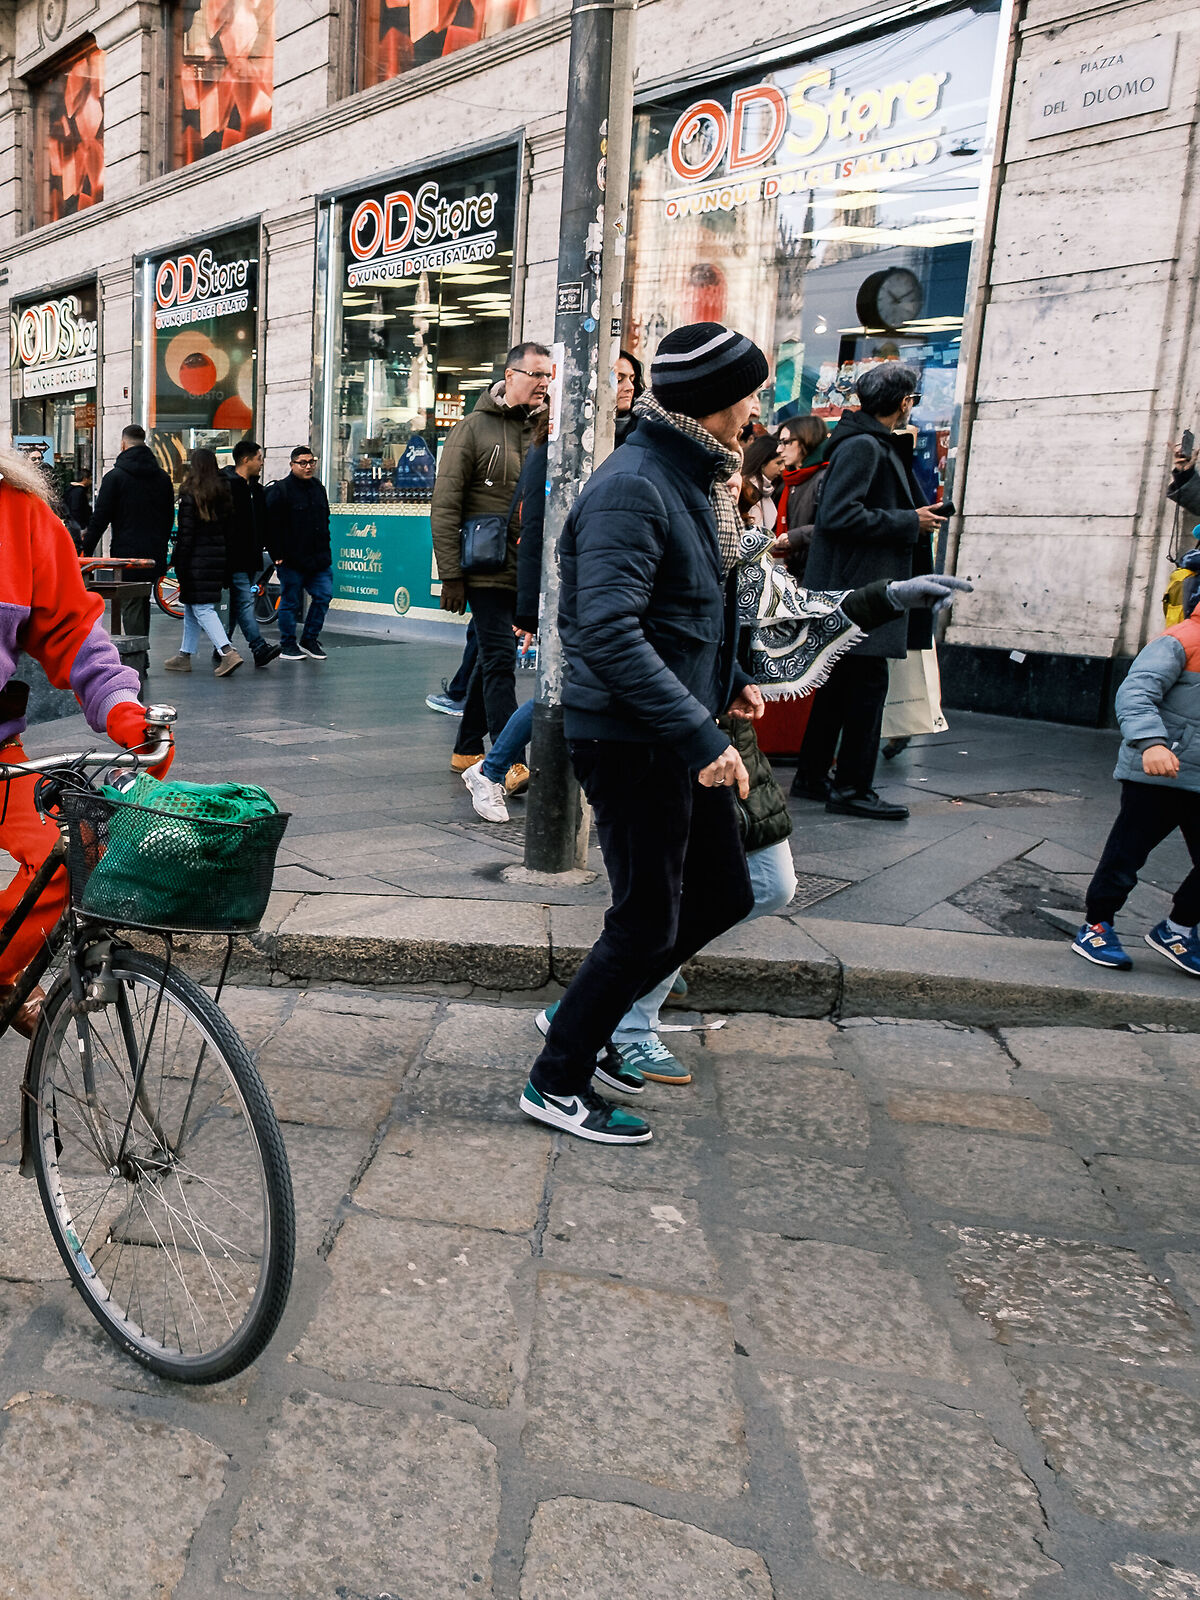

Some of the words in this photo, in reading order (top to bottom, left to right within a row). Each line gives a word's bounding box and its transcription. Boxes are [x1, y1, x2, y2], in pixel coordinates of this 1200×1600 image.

[1080, 54, 1124, 74] PIAZZA
[1042, 101, 1068, 117] DEL
[1082, 76, 1155, 108] DUOMO
[666, 184, 761, 218] OVUNQUE
[765, 167, 835, 198] DOLCE
[842, 141, 939, 178] SALATO
[349, 266, 402, 287] OVUNQUE
[405, 254, 442, 274] DOLCE
[446, 243, 495, 264] SALATO
[156, 312, 191, 329] OVUNQUE
[192, 304, 215, 321] DOLCE
[216, 297, 248, 316] SALATO
[346, 522, 371, 538] Lindt
[337, 560, 383, 573] CHOCOLATE
[340, 548, 363, 559] DUBAI
[363, 547, 382, 562] Style
